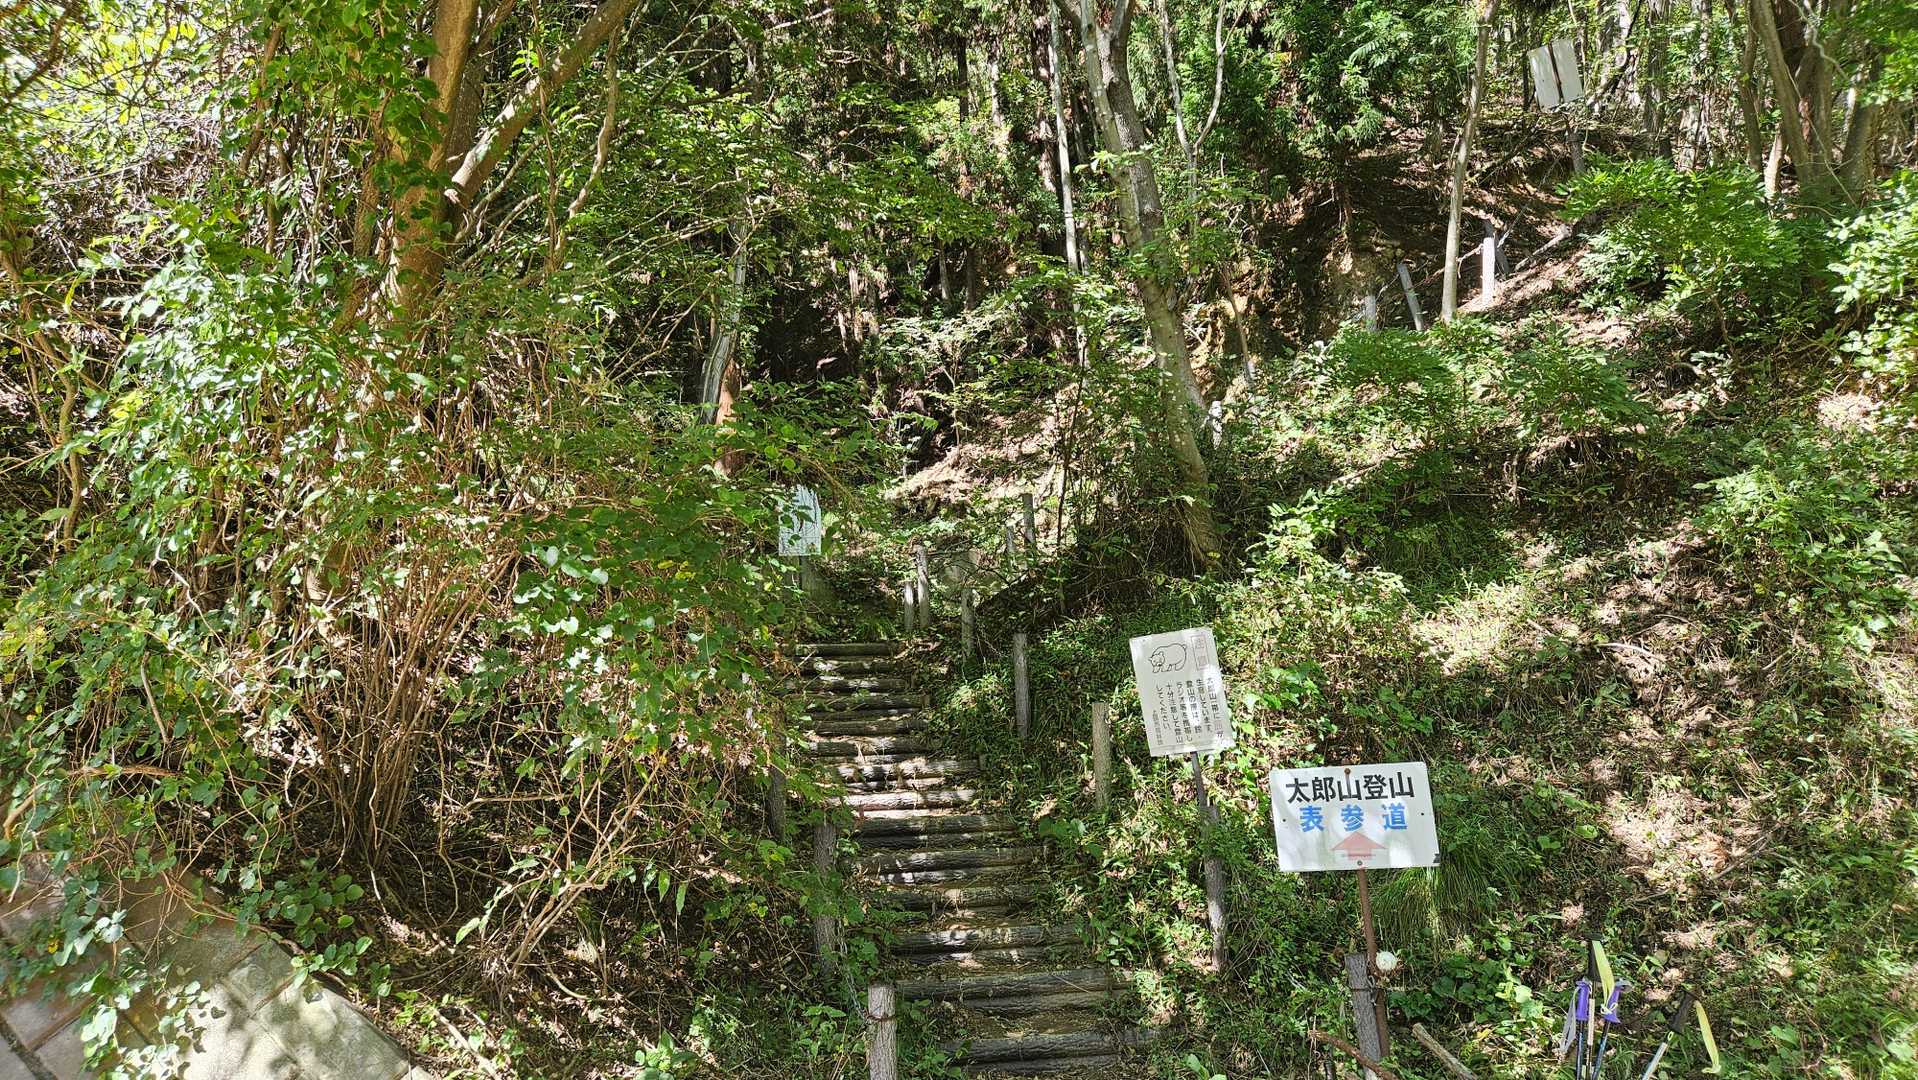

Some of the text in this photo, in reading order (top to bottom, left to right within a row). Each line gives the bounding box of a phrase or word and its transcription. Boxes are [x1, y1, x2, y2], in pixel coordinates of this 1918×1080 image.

[1286, 772, 1415, 803] 太郎山登山
[1300, 803, 1407, 832] 表参道
